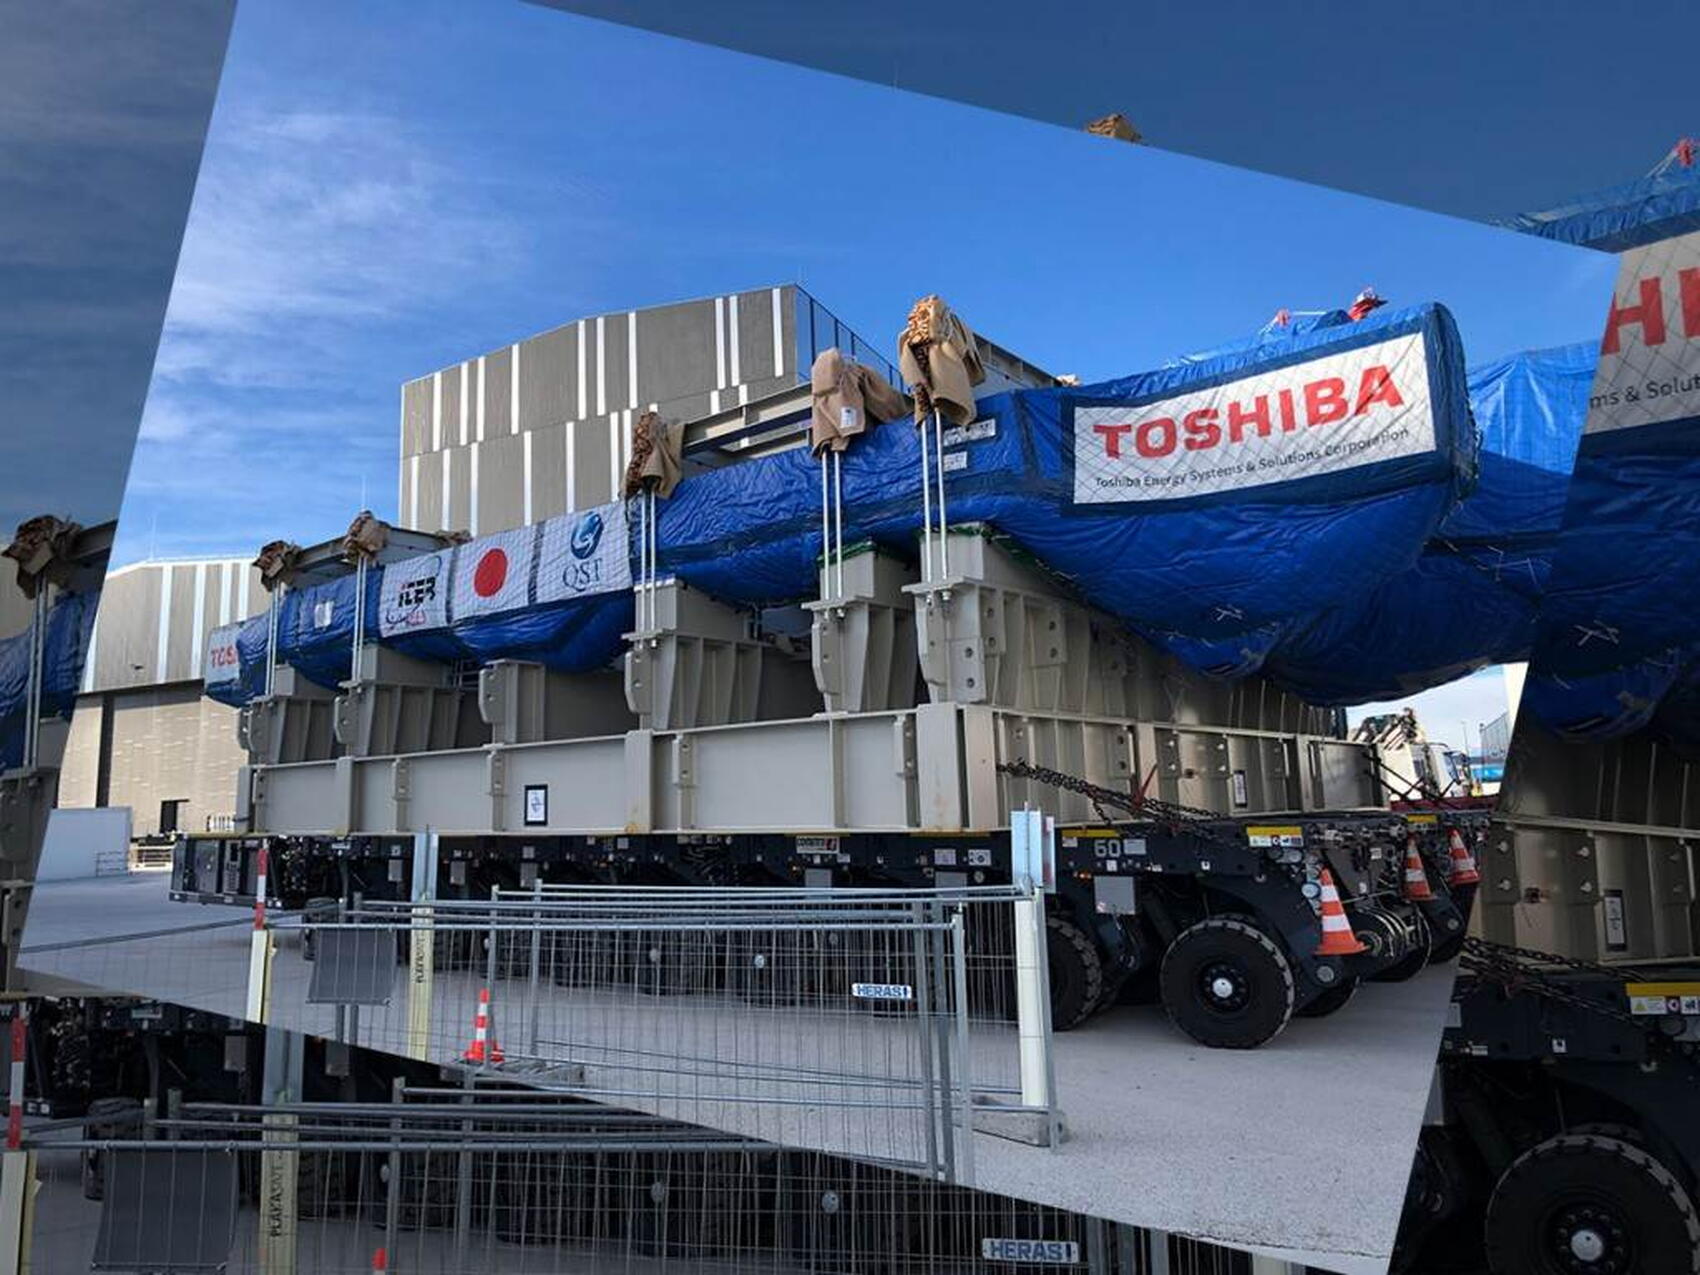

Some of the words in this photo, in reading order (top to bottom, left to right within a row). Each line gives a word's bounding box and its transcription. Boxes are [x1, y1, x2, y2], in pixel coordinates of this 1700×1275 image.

[1625, 385, 1640, 402] &
[1093, 364, 1404, 460] TOSHIBA
[1096, 476, 1140, 488] Toshiba
[1143, 472, 1187, 488] Energy
[1190, 464, 1243, 483] Systems
[1245, 460, 1256, 472] &
[1259, 449, 1322, 468] Solutions
[1325, 428, 1409, 458] Corporation
[562, 557, 603, 592] QST
[1094, 839, 1121, 857] 60
